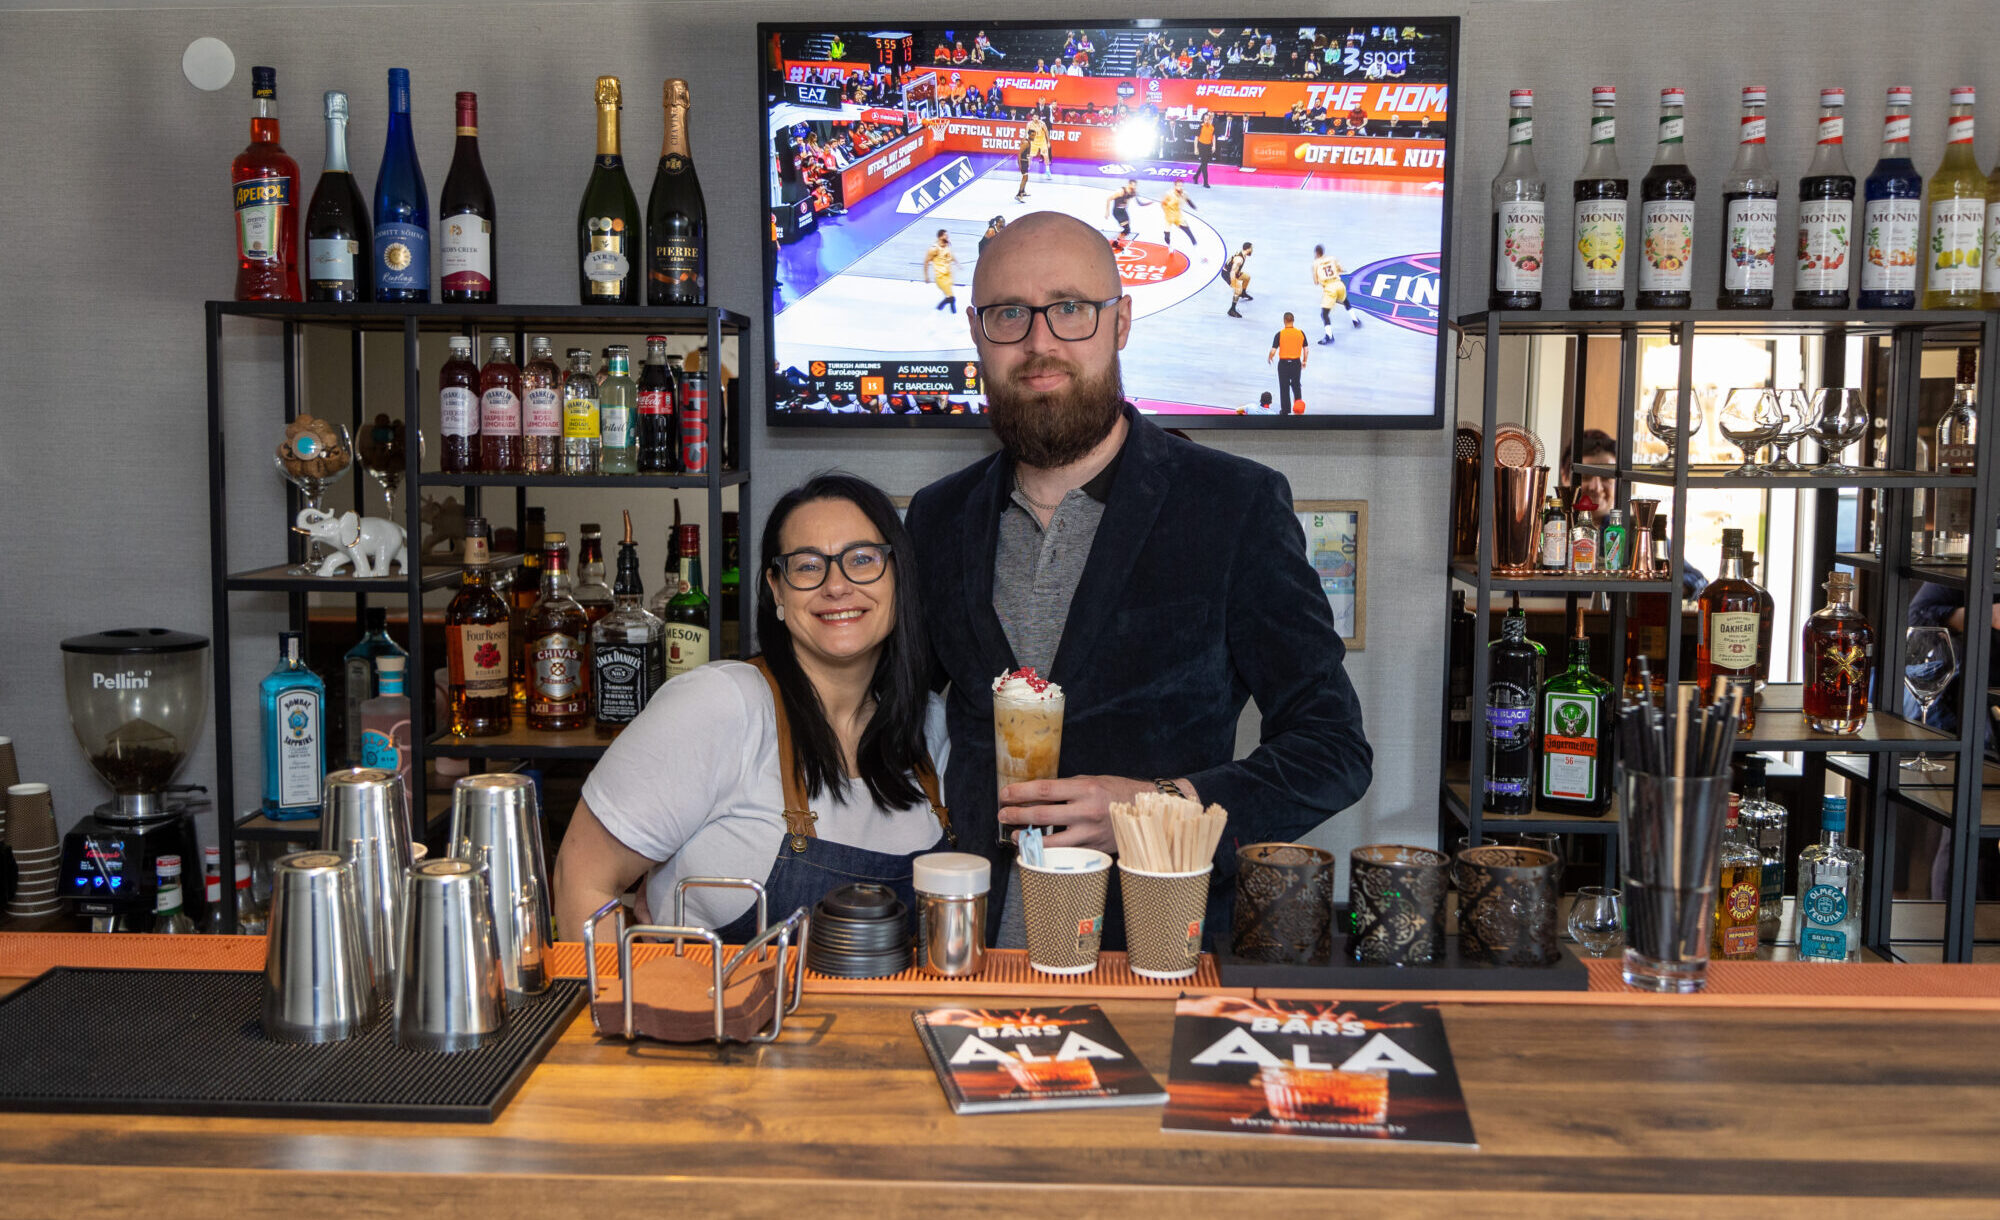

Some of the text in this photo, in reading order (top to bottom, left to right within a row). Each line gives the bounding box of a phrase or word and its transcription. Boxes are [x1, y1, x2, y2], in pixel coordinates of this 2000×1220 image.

[1363, 48, 1416, 67] sport
[996, 77, 1058, 90] #F4GLORY
[798, 86, 826, 101] EA7
[1196, 84, 1267, 98] #F4GLORY
[1306, 85, 1448, 112] THE HOM
[948, 123, 992, 137] OFFICIAL
[996, 126, 1016, 138] NUT
[1068, 131, 1082, 142] OF
[983, 138, 1021, 150] EUROLE
[1305, 145, 1445, 168] OFFICIAL NUT
[236, 185, 284, 206] APEROL
[1579, 212, 1624, 224] MONIN
[1648, 212, 1692, 224] MONIN
[1801, 212, 1846, 224] MONIN
[1872, 212, 1919, 223] MONIN
[1936, 212, 1984, 224] MONIN
[656, 247, 699, 257] PIERRE
[828, 369, 869, 377] EuroLeague
[898, 365, 949, 374] AS MONACO
[835, 382, 854, 391] 5:55
[893, 382, 954, 391] FC BARCELONA
[486, 390, 512, 401] FRANKLIN
[529, 390, 556, 401] FRANKLIN
[1314, 514, 1324, 528] 20
[1341, 534, 1356, 554] 20
[1720, 623, 1754, 633] OAKHEART
[466, 629, 507, 642] Four Roses
[666, 629, 702, 646] MESON
[537, 650, 578, 660] CHIVAS
[597, 653, 613, 669] JACK
[93, 670, 152, 690] Pellini
[284, 698, 312, 711] BOMBAY
[568, 703, 578, 712] 12
[1500, 710, 1527, 719] BLACK
[284, 734, 314, 746] SAPPHIRE
[1564, 756, 1574, 766] 56
[1730, 884, 1756, 899] OLMECA
[1809, 888, 1841, 904] OLMECA
[1730, 904, 1756, 920] TEQUILA
[1808, 907, 1843, 923] TEQUILA
[1811, 934, 1836, 943] SILVER
[1251, 1013, 1367, 1037] BĀRS
[949, 1030, 1124, 1065] ALA
[1190, 1026, 1438, 1076] ALA
